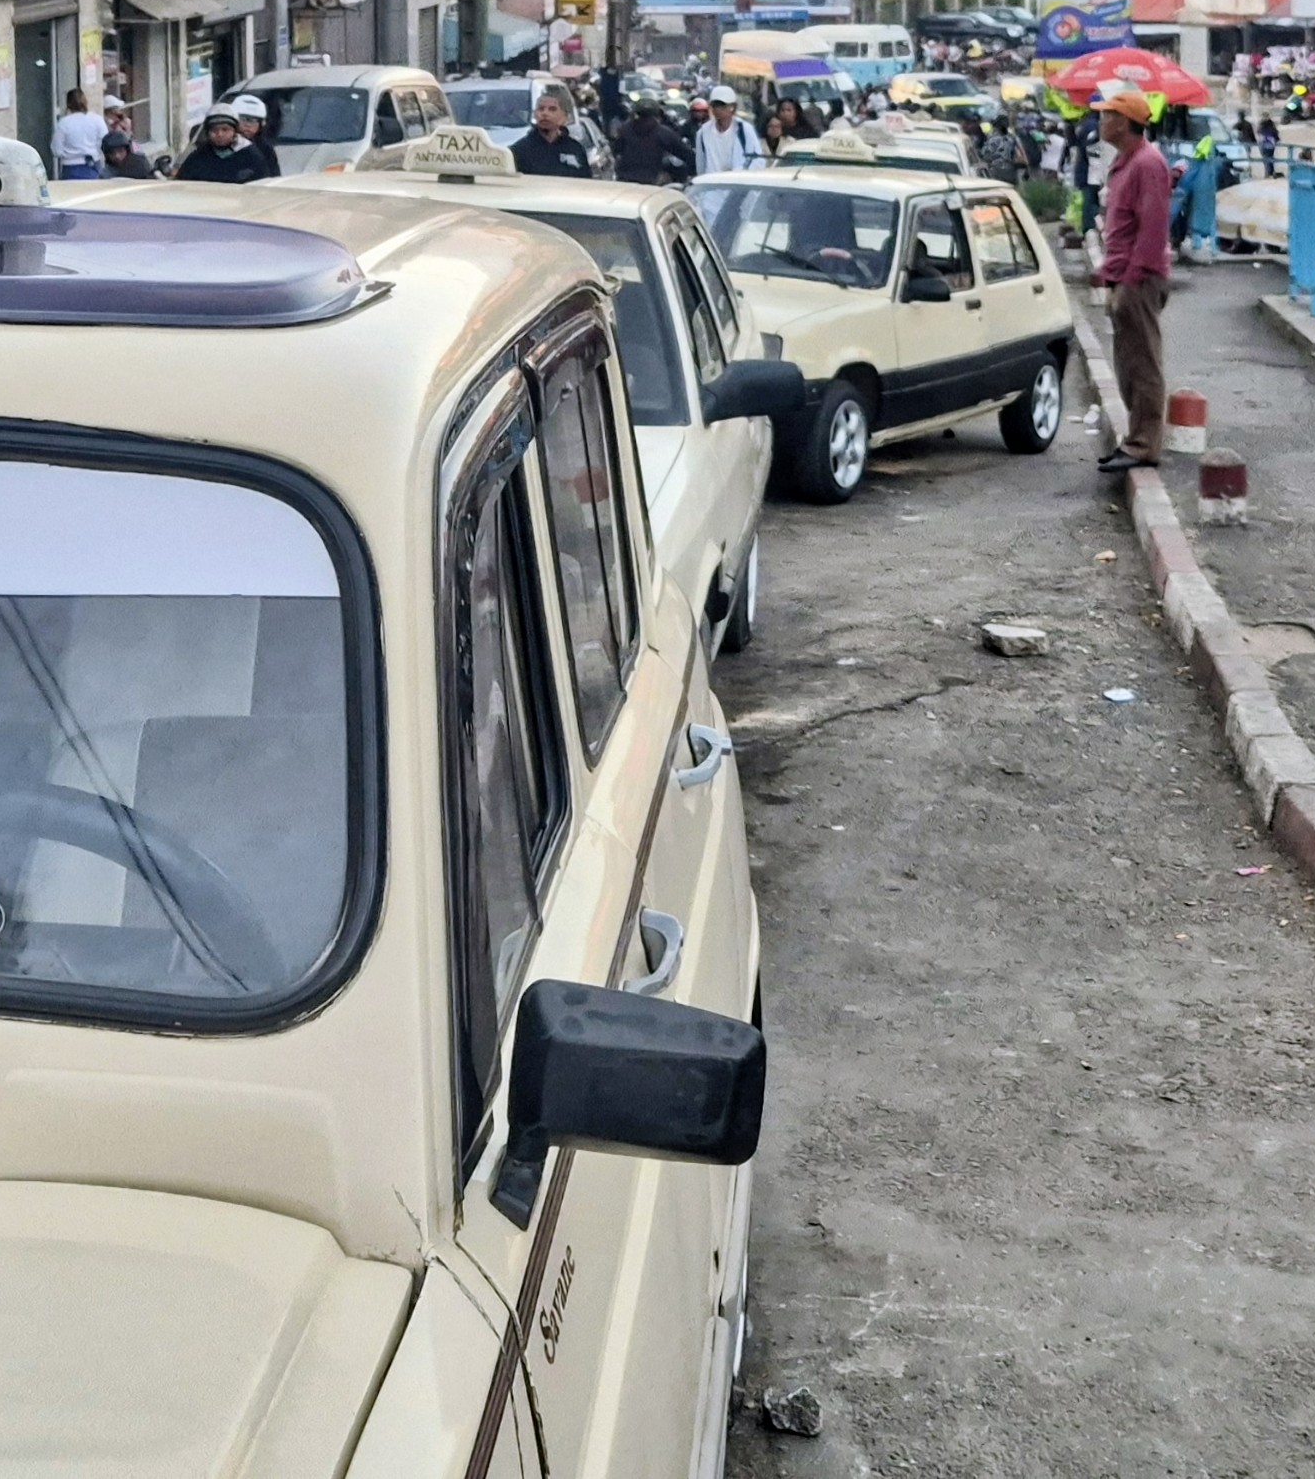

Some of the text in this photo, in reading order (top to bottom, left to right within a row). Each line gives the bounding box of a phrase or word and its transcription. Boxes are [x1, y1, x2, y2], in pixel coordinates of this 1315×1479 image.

[436, 133, 481, 153] TAXI
[832, 137, 855, 148] TAXI
[414, 151, 502, 167] ANTANANARIVO
[539, 1244, 575, 1365] Savane
